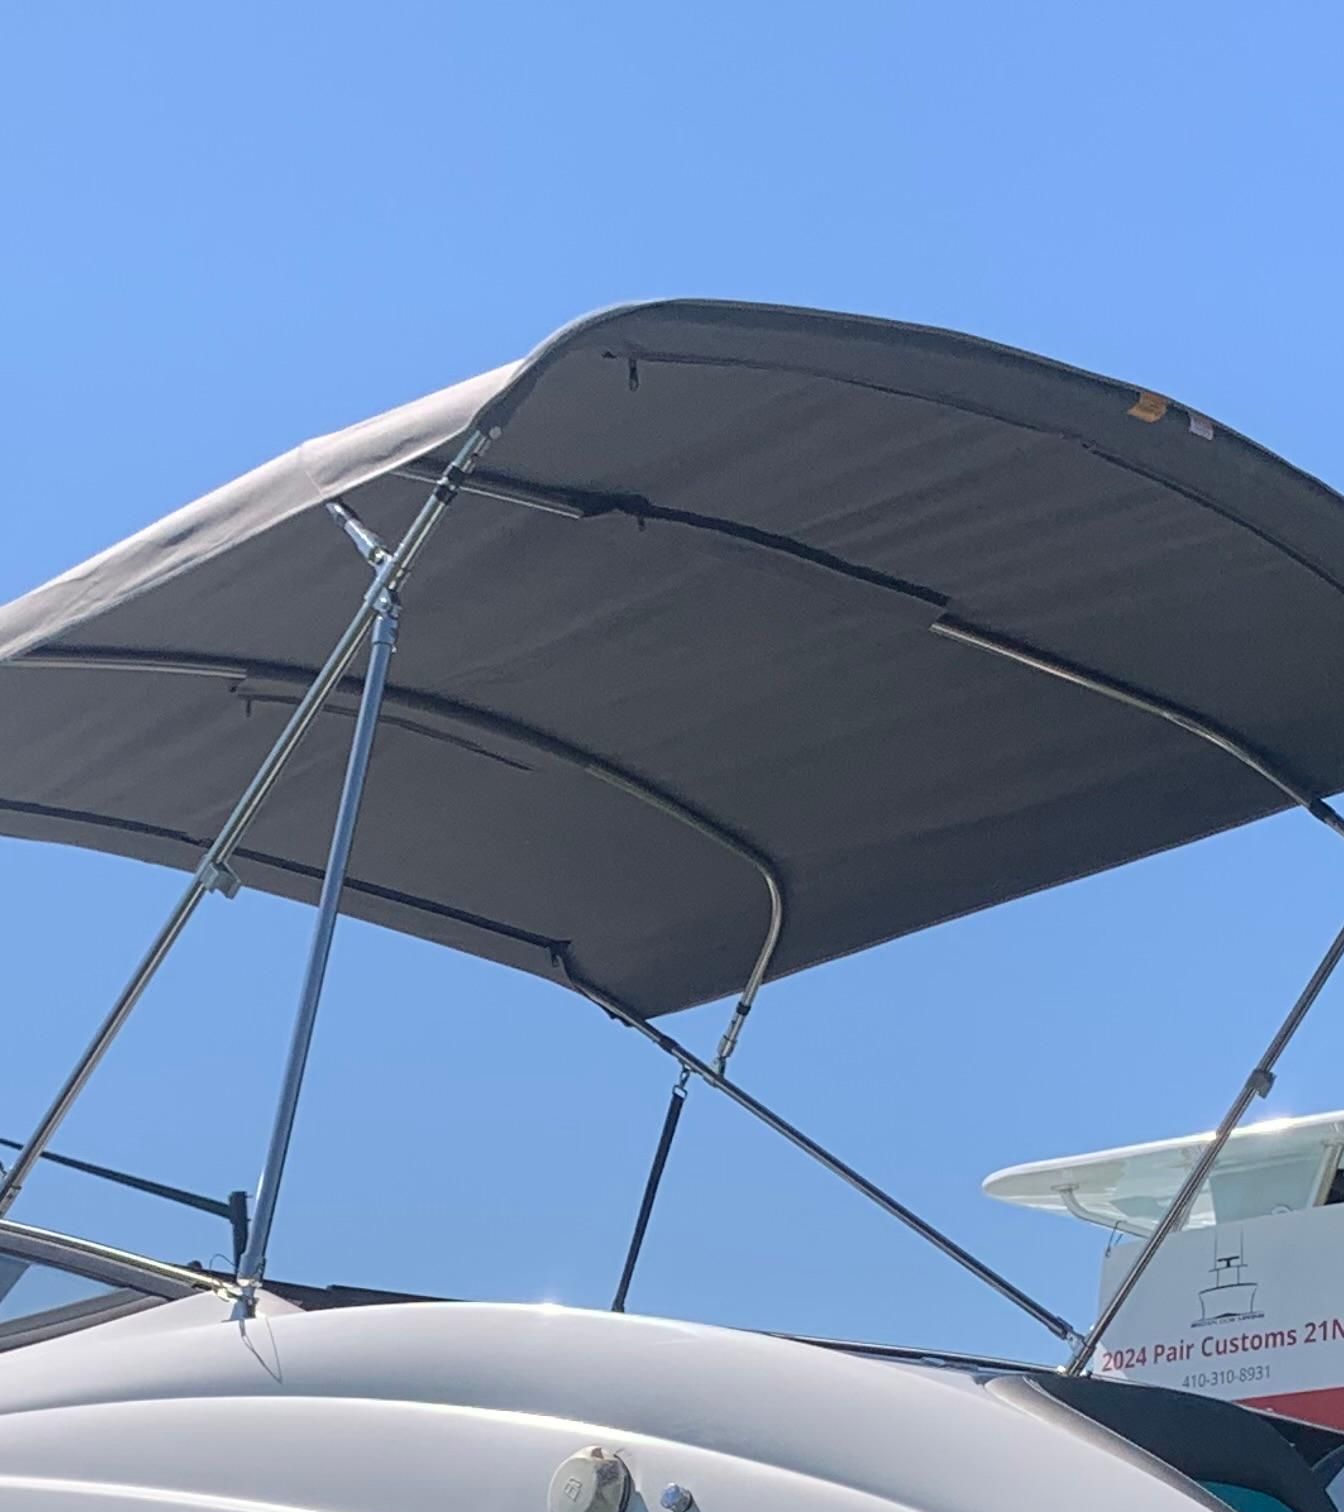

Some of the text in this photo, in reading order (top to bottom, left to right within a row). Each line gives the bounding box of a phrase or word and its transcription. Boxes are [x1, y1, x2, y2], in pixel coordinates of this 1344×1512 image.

[1102, 1346, 1147, 1372] 2024
[1153, 1343, 1195, 1364] Pair
[1201, 1328, 1298, 1358] Customs
[1182, 1364, 1272, 1389] 410-310-8931
